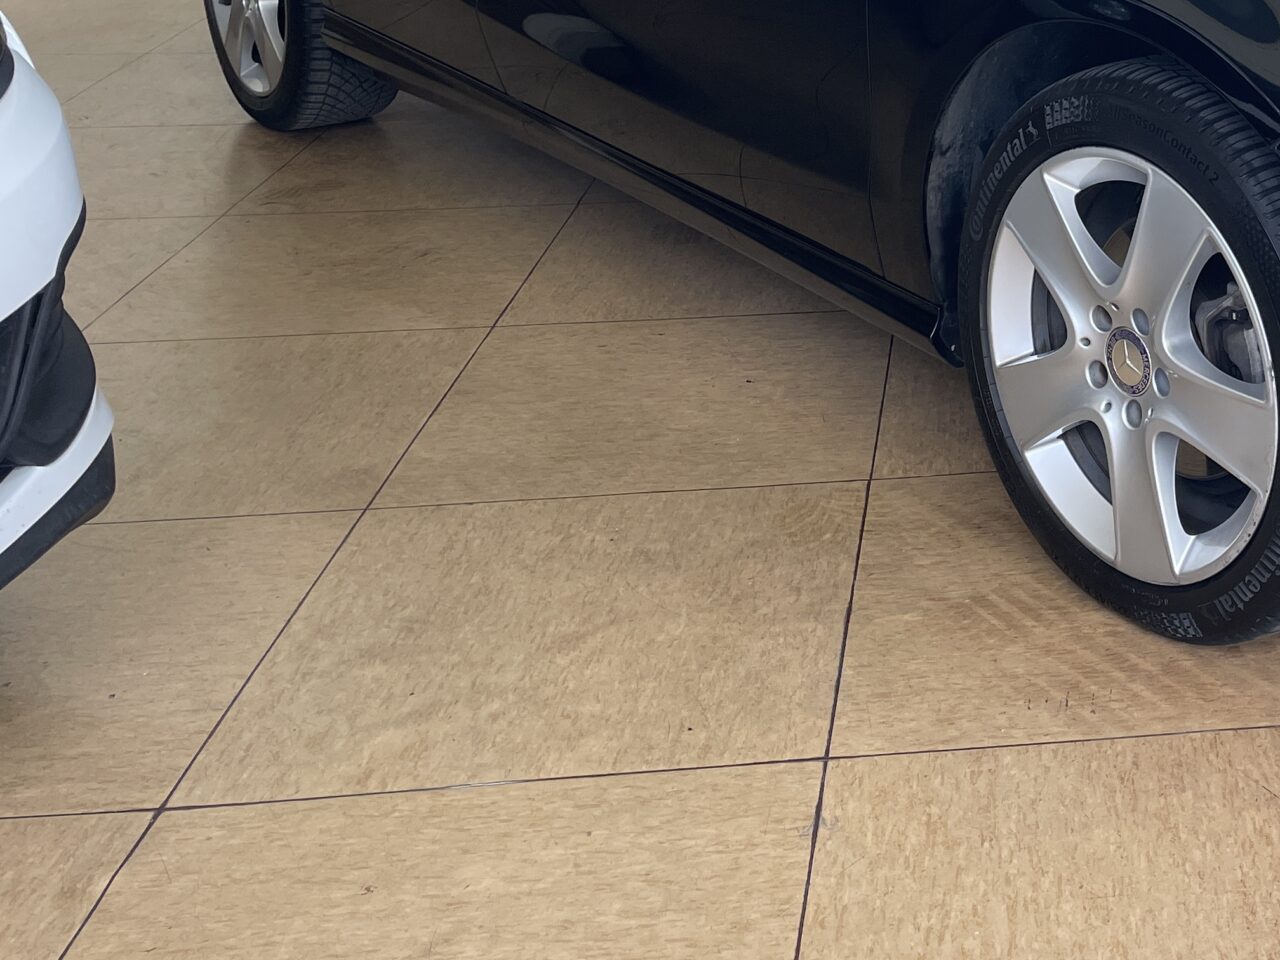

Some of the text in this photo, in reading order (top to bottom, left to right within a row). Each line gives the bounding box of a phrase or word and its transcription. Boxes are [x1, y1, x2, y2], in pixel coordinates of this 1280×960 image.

[970, 127, 1028, 242] Continental
[1208, 171, 1220, 186] 2
[1134, 353, 1151, 393] MERCEDES
